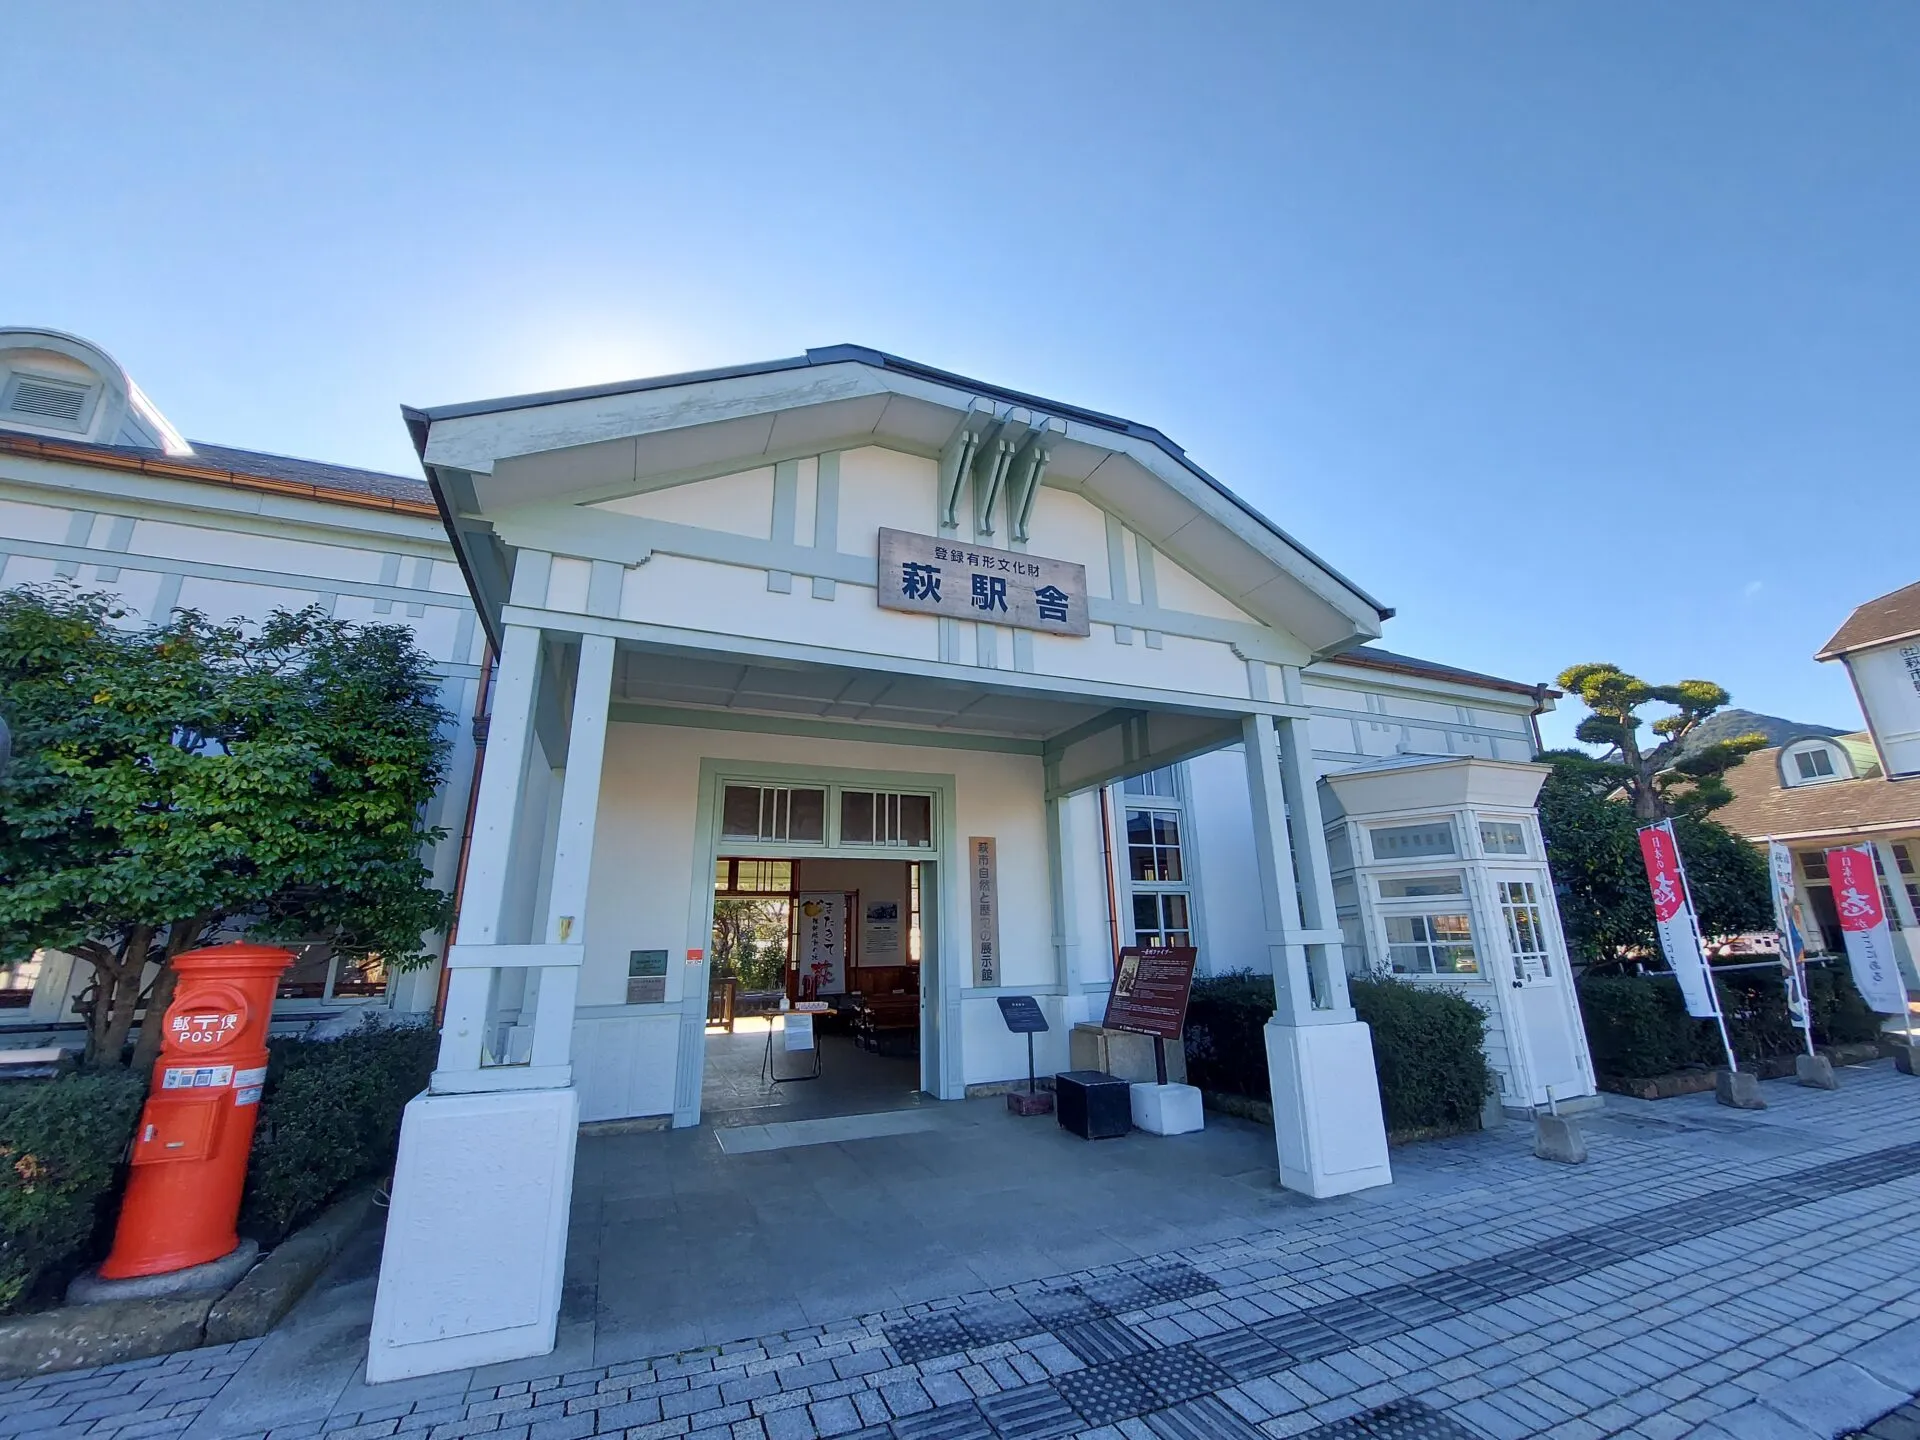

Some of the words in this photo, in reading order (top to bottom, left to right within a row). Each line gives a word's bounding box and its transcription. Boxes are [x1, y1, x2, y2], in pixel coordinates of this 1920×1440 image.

[934, 546, 1040, 578] 登録有形文化財
[902, 561, 1069, 623] 萩駅舎
[179, 1030, 225, 1043] POST
